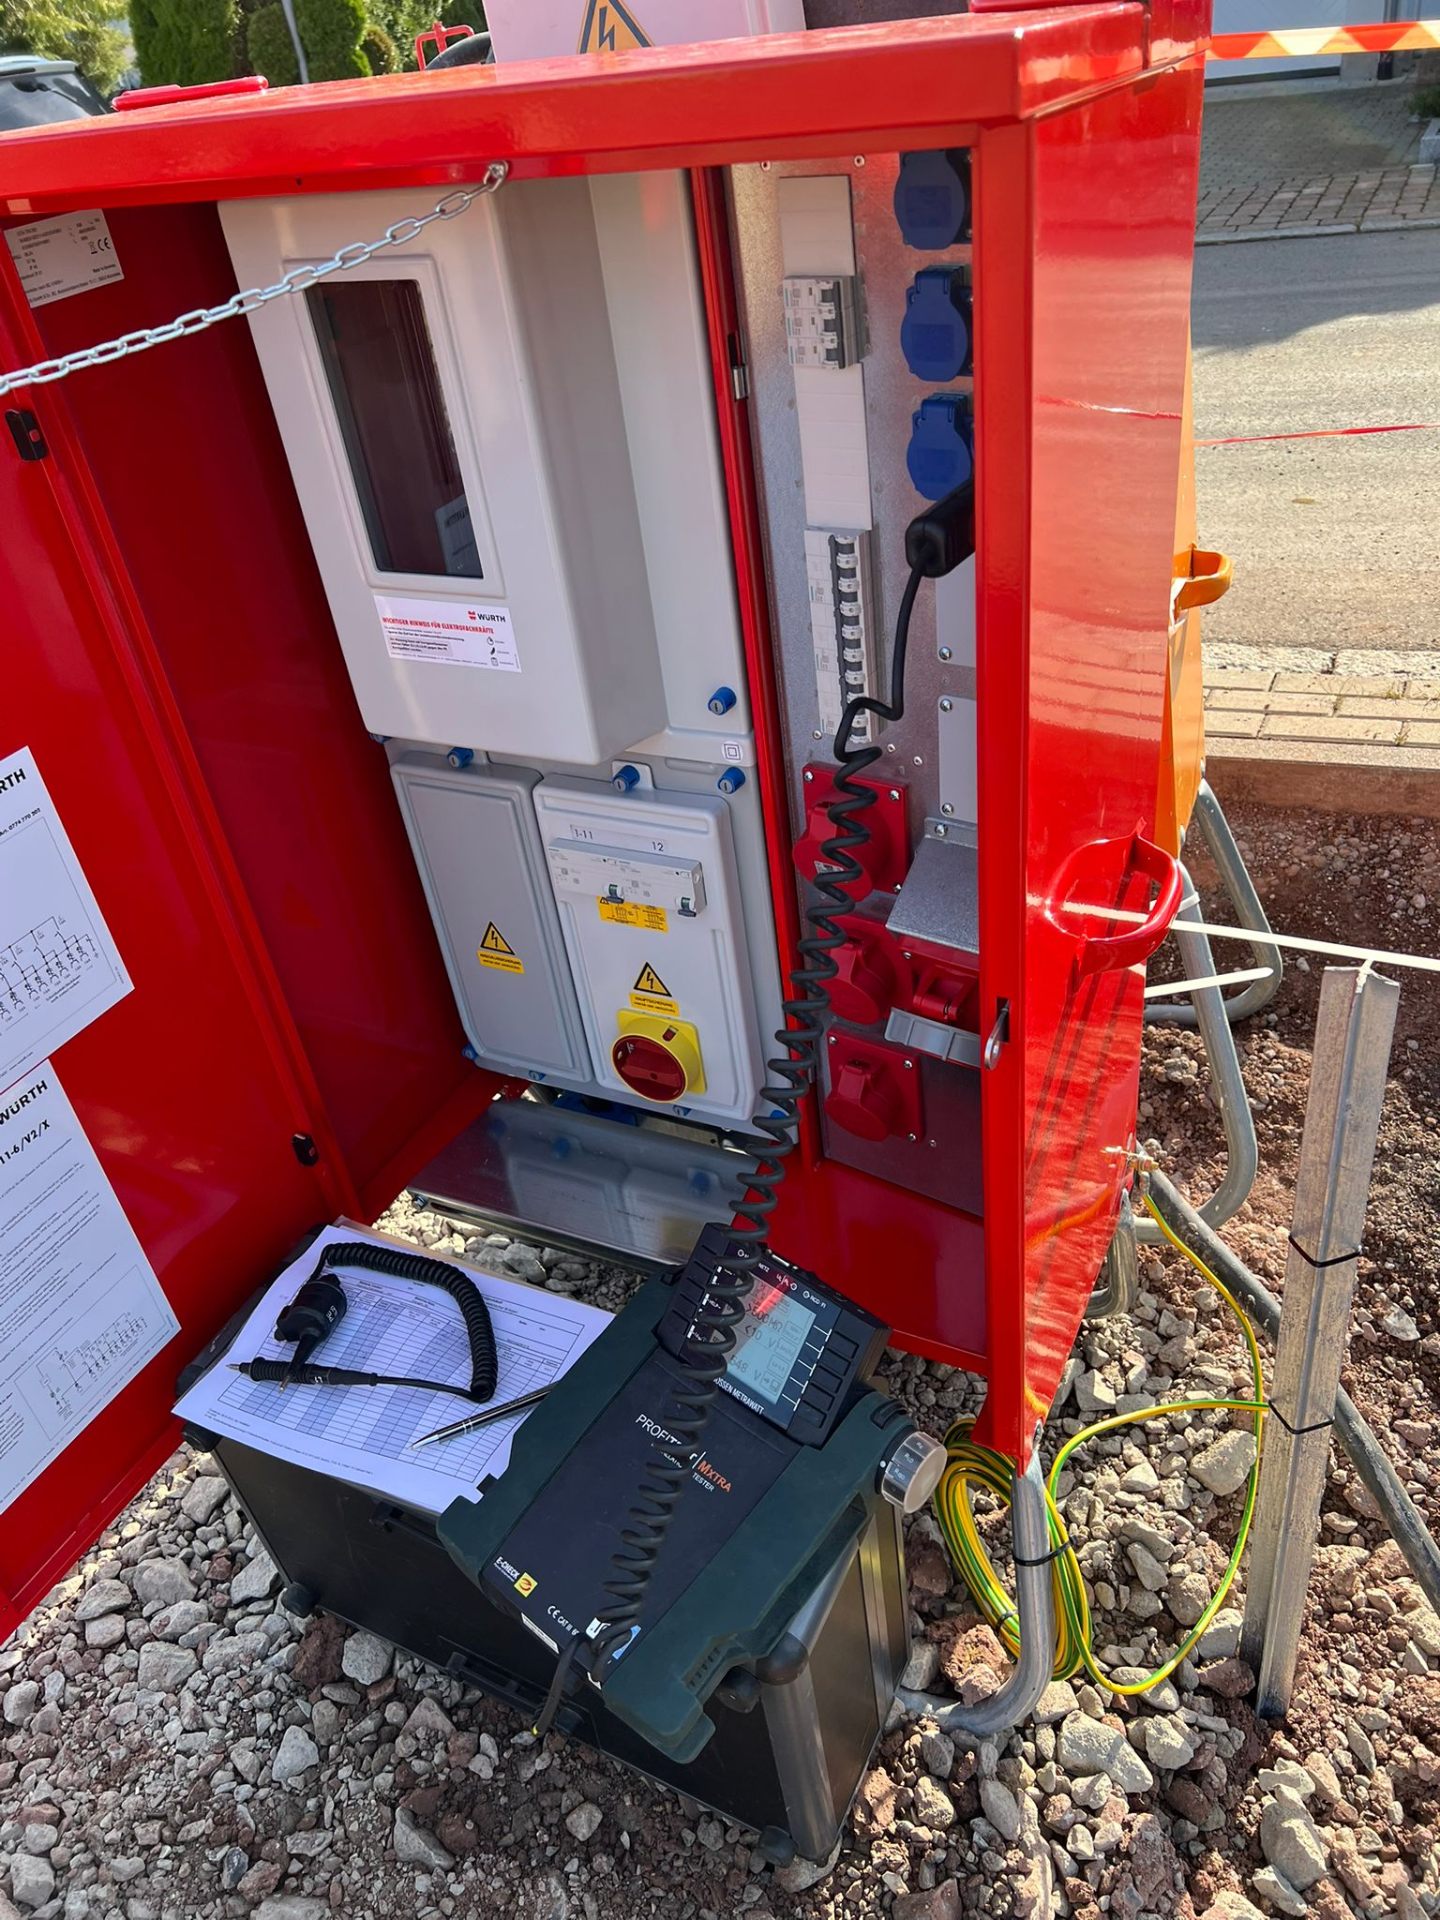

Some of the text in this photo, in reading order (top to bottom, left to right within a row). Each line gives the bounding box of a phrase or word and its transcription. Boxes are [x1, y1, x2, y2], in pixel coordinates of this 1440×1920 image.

[477, 612, 506, 623] WÜRTH
[574, 828, 664, 852] 1-11 12
[713, 1377, 765, 1415] OSSEN METRAWATT
[692, 1471, 715, 1493] TESTER
